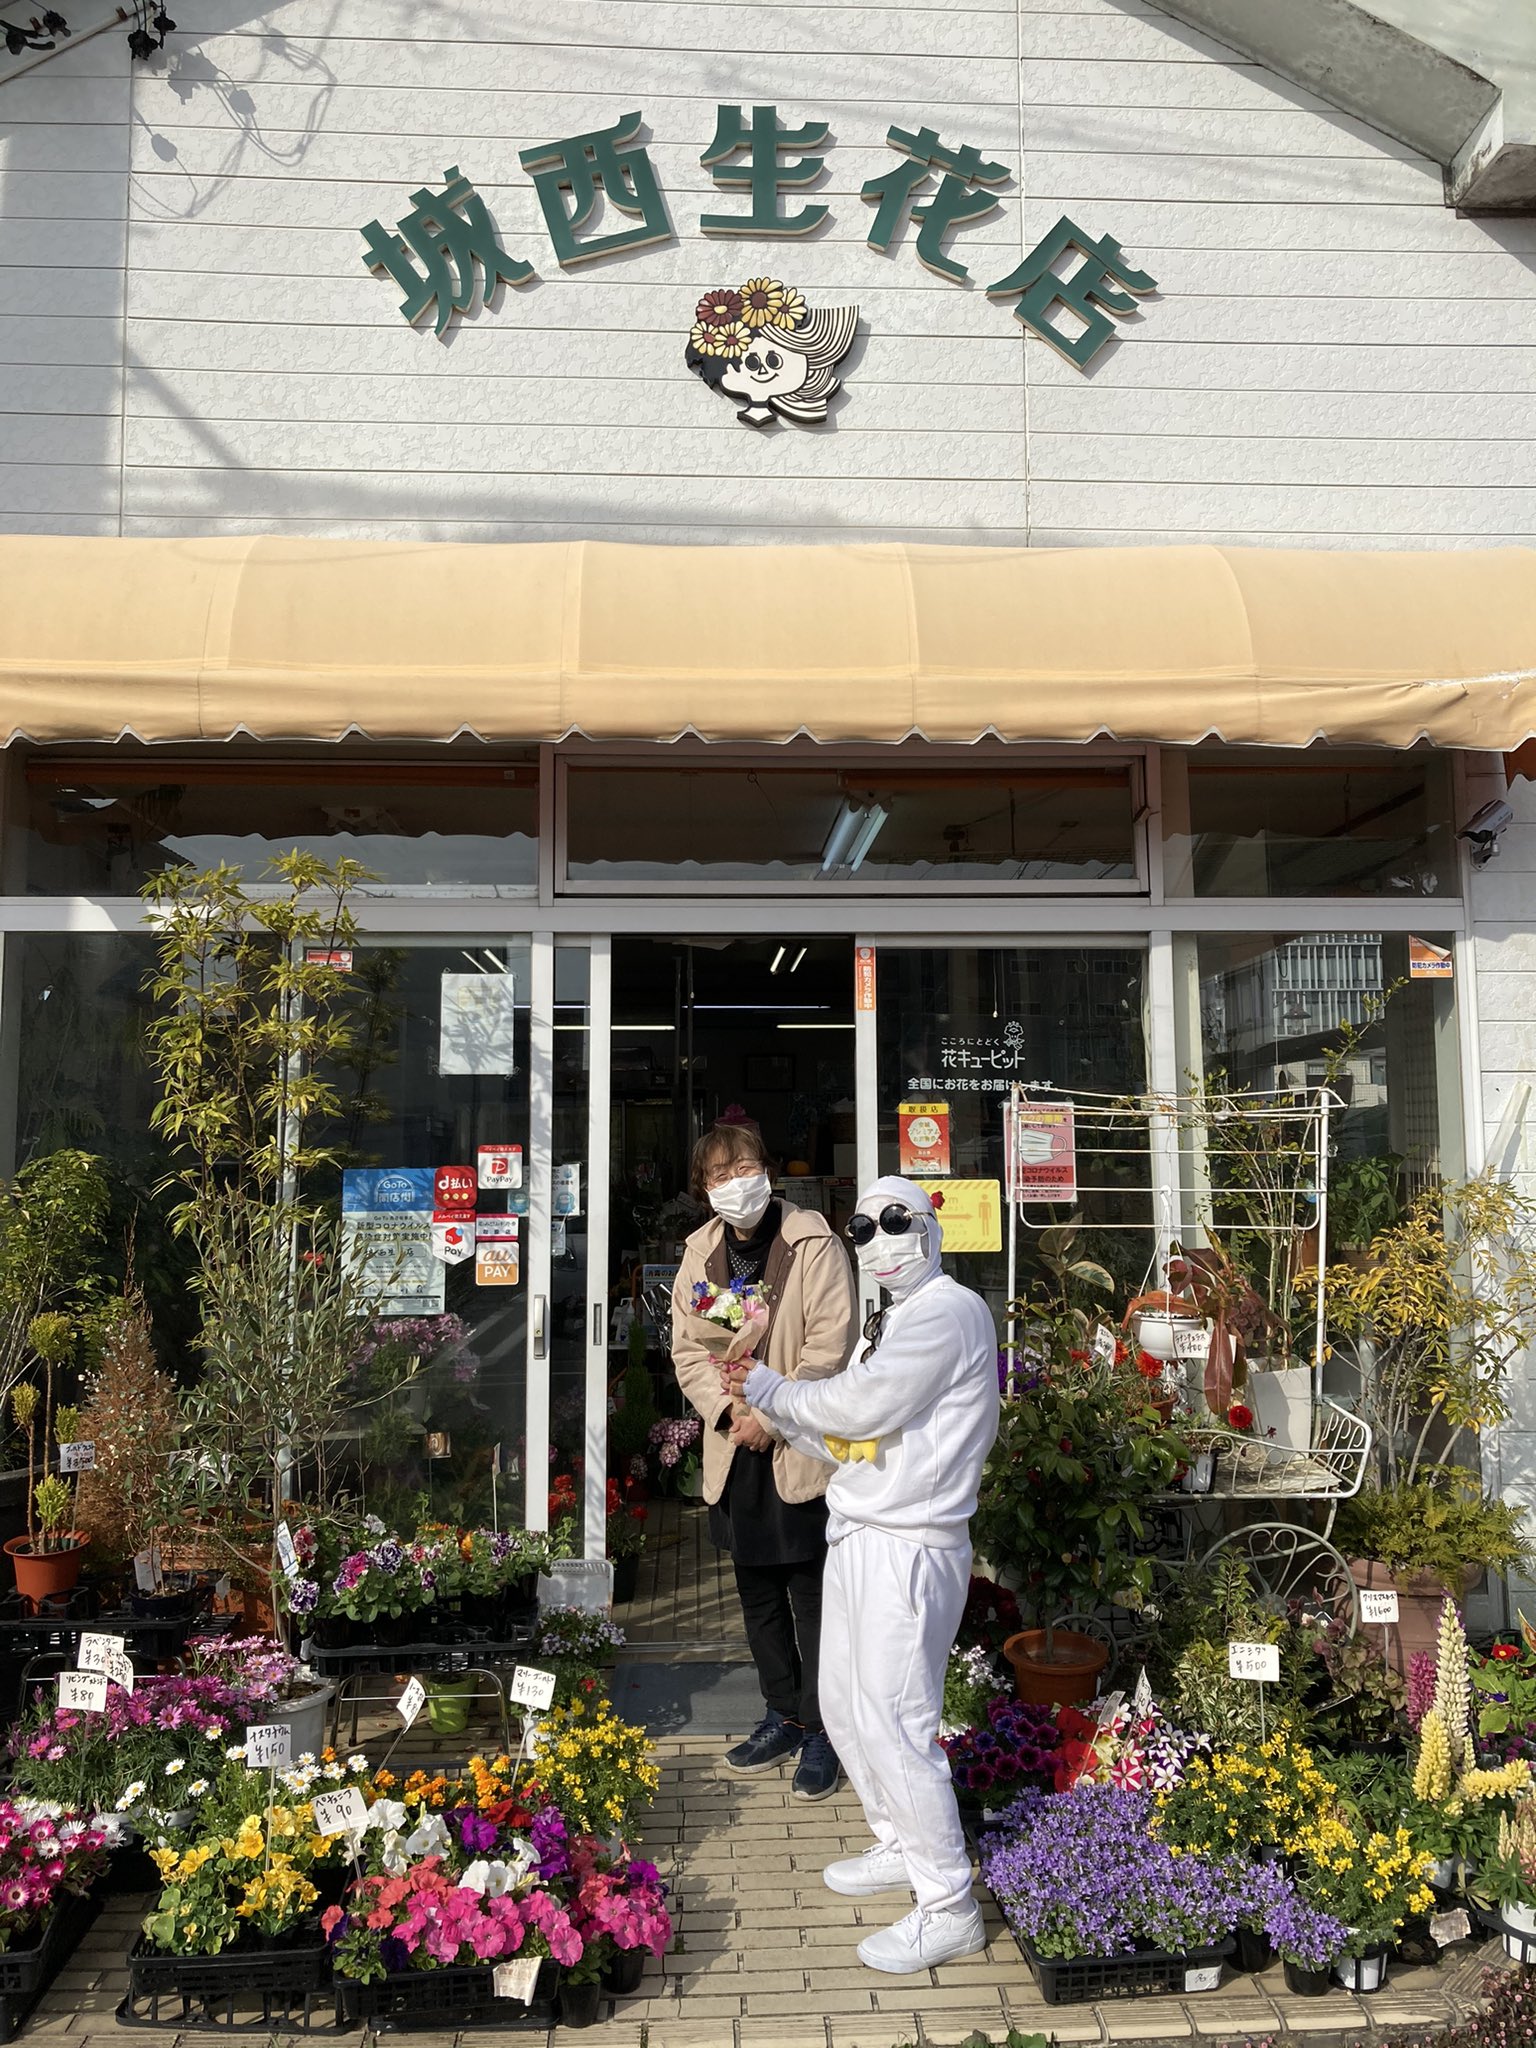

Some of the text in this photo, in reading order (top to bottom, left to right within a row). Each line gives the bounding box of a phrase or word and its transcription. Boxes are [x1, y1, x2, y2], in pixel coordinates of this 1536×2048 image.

[360, 105, 1158, 370] 城西生花店
[941, 1037, 1000, 1046] こころにとどく
[941, 1048, 1026, 1069] 花キューピット
[438, 1175, 473, 1190] d払い
[356, 1222, 431, 1230] 新型コロナウイルス
[444, 1246, 463, 1257] Pay
[483, 1249, 512, 1262] au
[484, 1265, 511, 1278] PAY
[85, 1636, 119, 1647] ラベンダー
[1235, 1659, 1267, 1674] ¥500
[70, 1688, 95, 1702] ¥80
[517, 1681, 545, 1697] ¥130
[255, 1742, 285, 1764] ¥150
[316, 1789, 353, 1808] ペチュニア
[320, 1804, 352, 1824] ¥90
